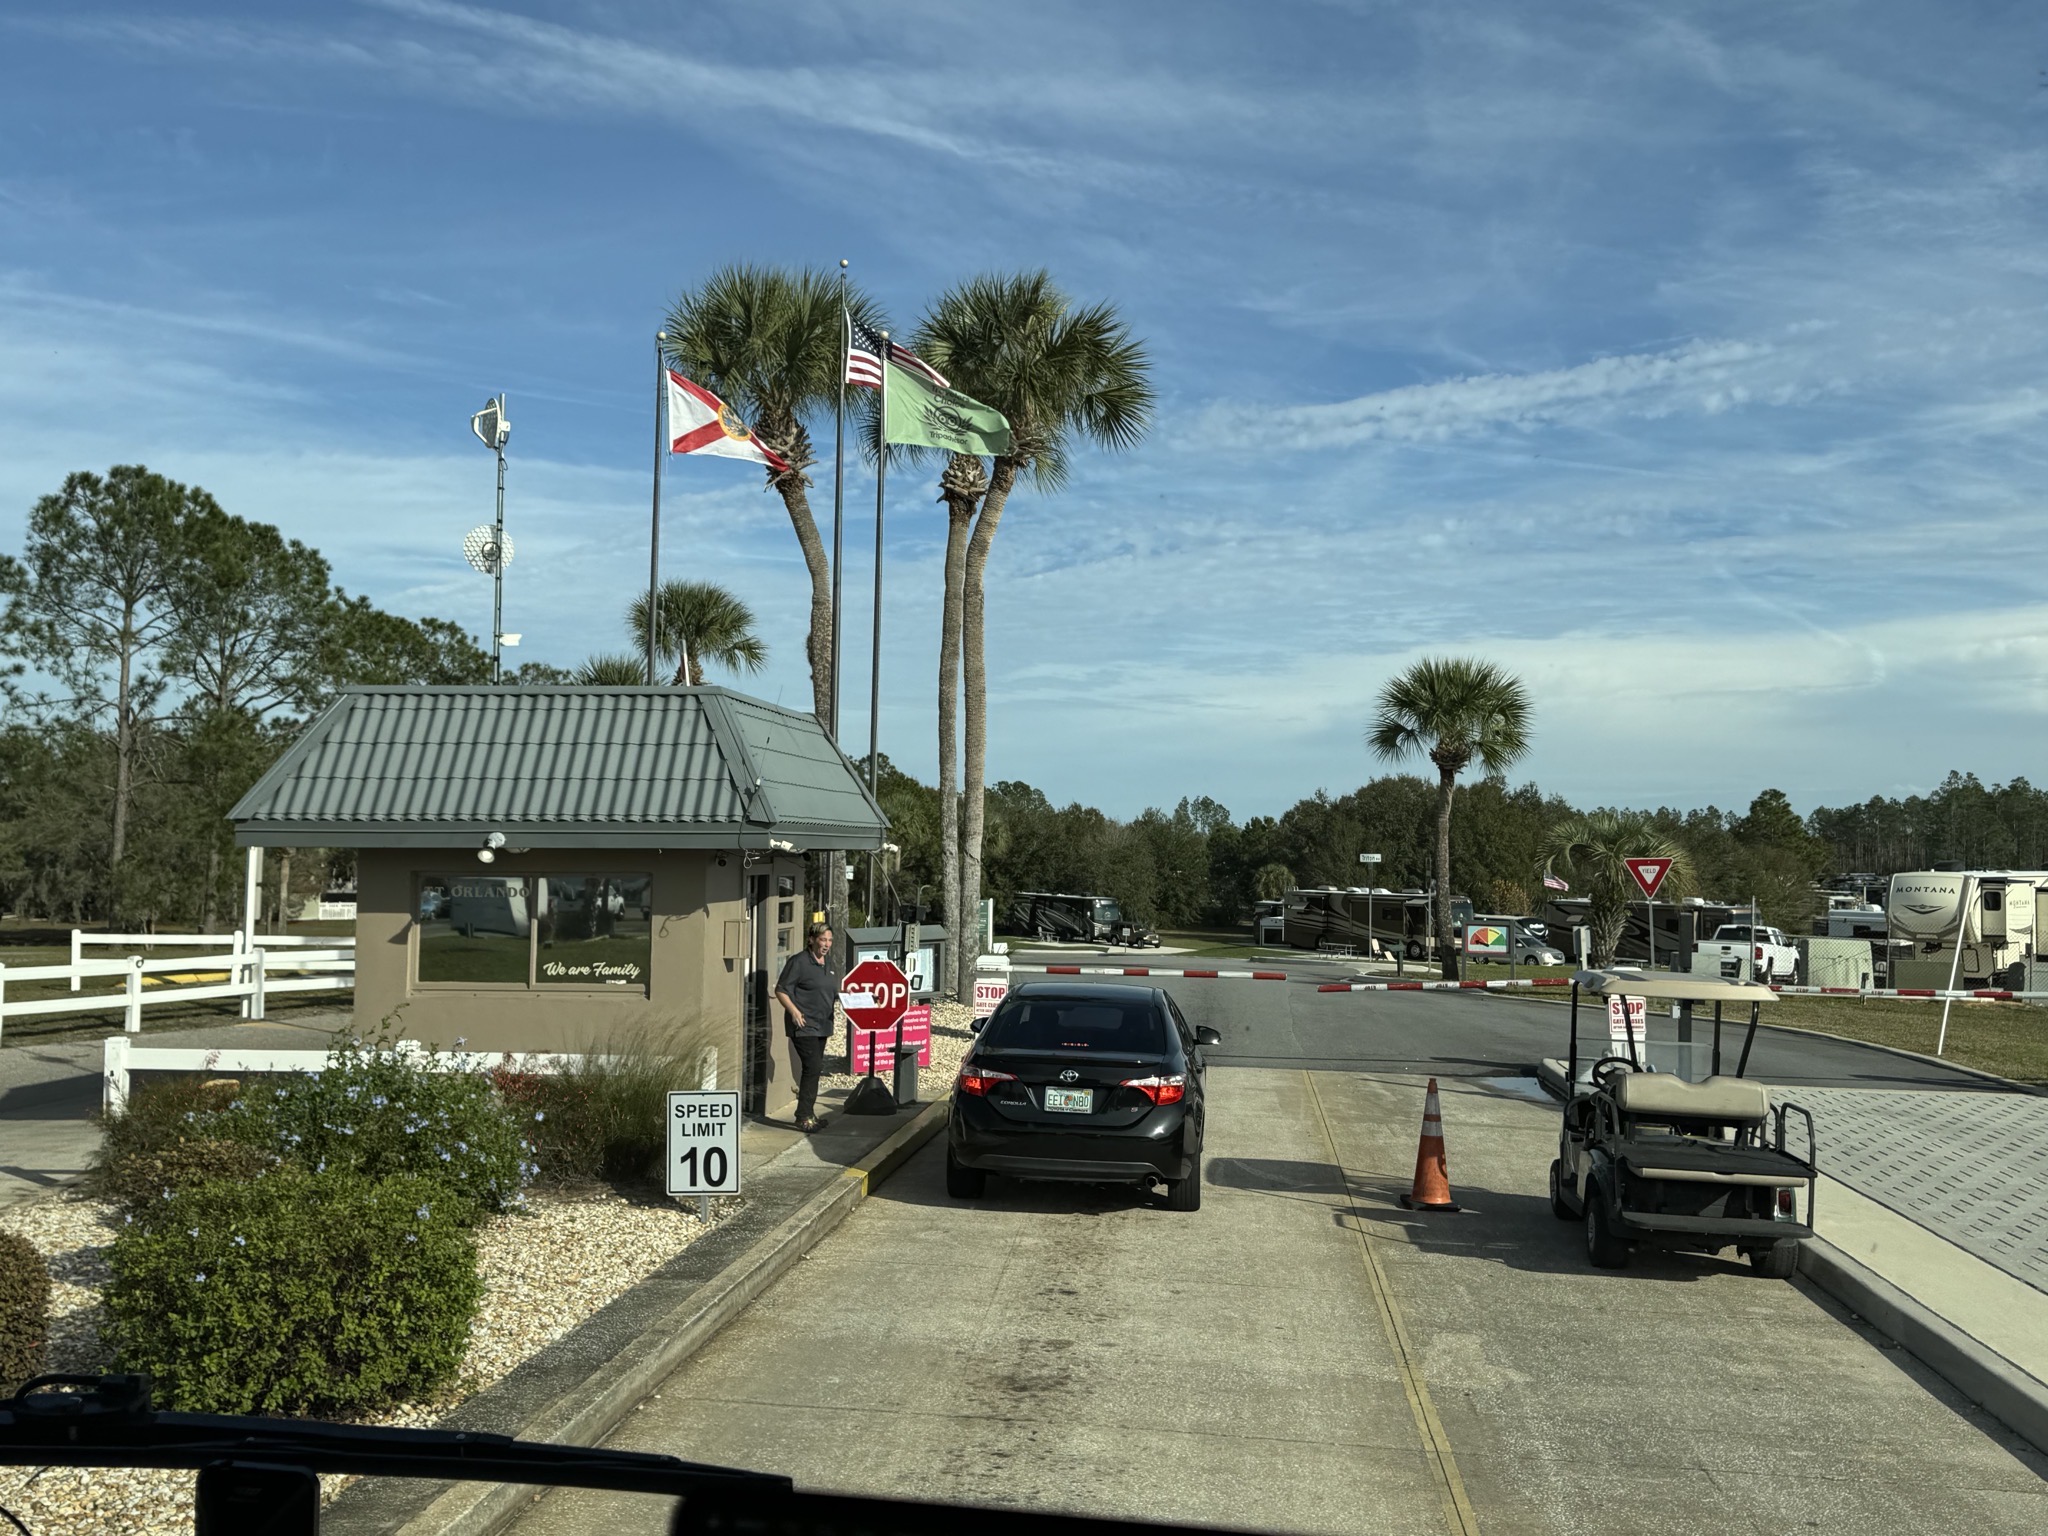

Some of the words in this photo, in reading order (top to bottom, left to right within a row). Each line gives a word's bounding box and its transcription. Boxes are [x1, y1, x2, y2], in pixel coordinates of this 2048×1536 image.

[451, 885, 530, 898] ORLANDO
[1896, 886, 1955, 895] MONTANA
[543, 962, 567, 976] We
[568, 966, 591, 976] are
[593, 962, 641, 979] Family
[977, 986, 1005, 999] STOP
[674, 1104, 733, 1118] SPEED
[682, 1123, 726, 1137] LIMIT
[680, 1146, 728, 1188] 10
